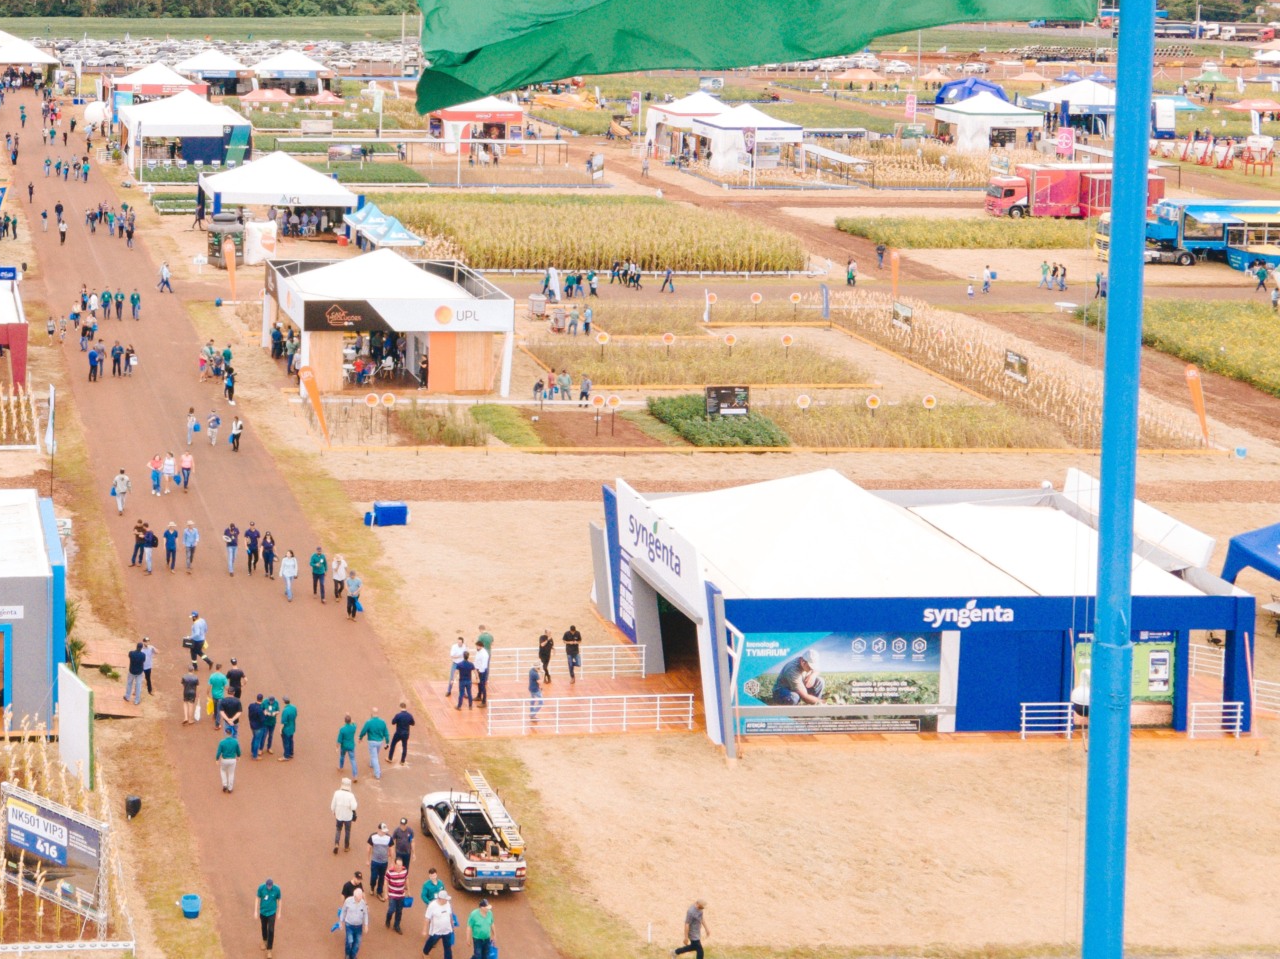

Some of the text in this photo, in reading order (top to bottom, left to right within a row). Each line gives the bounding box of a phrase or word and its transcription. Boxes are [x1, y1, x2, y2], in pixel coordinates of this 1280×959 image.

[289, 196, 302, 204] ICL
[456, 309, 480, 322] UPL
[629, 514, 681, 577] syngenta
[923, 602, 1014, 628] syngenta
[12, 808, 40, 829] NK501
[43, 820, 64, 840] VIP3
[36, 838, 58, 858] 416
